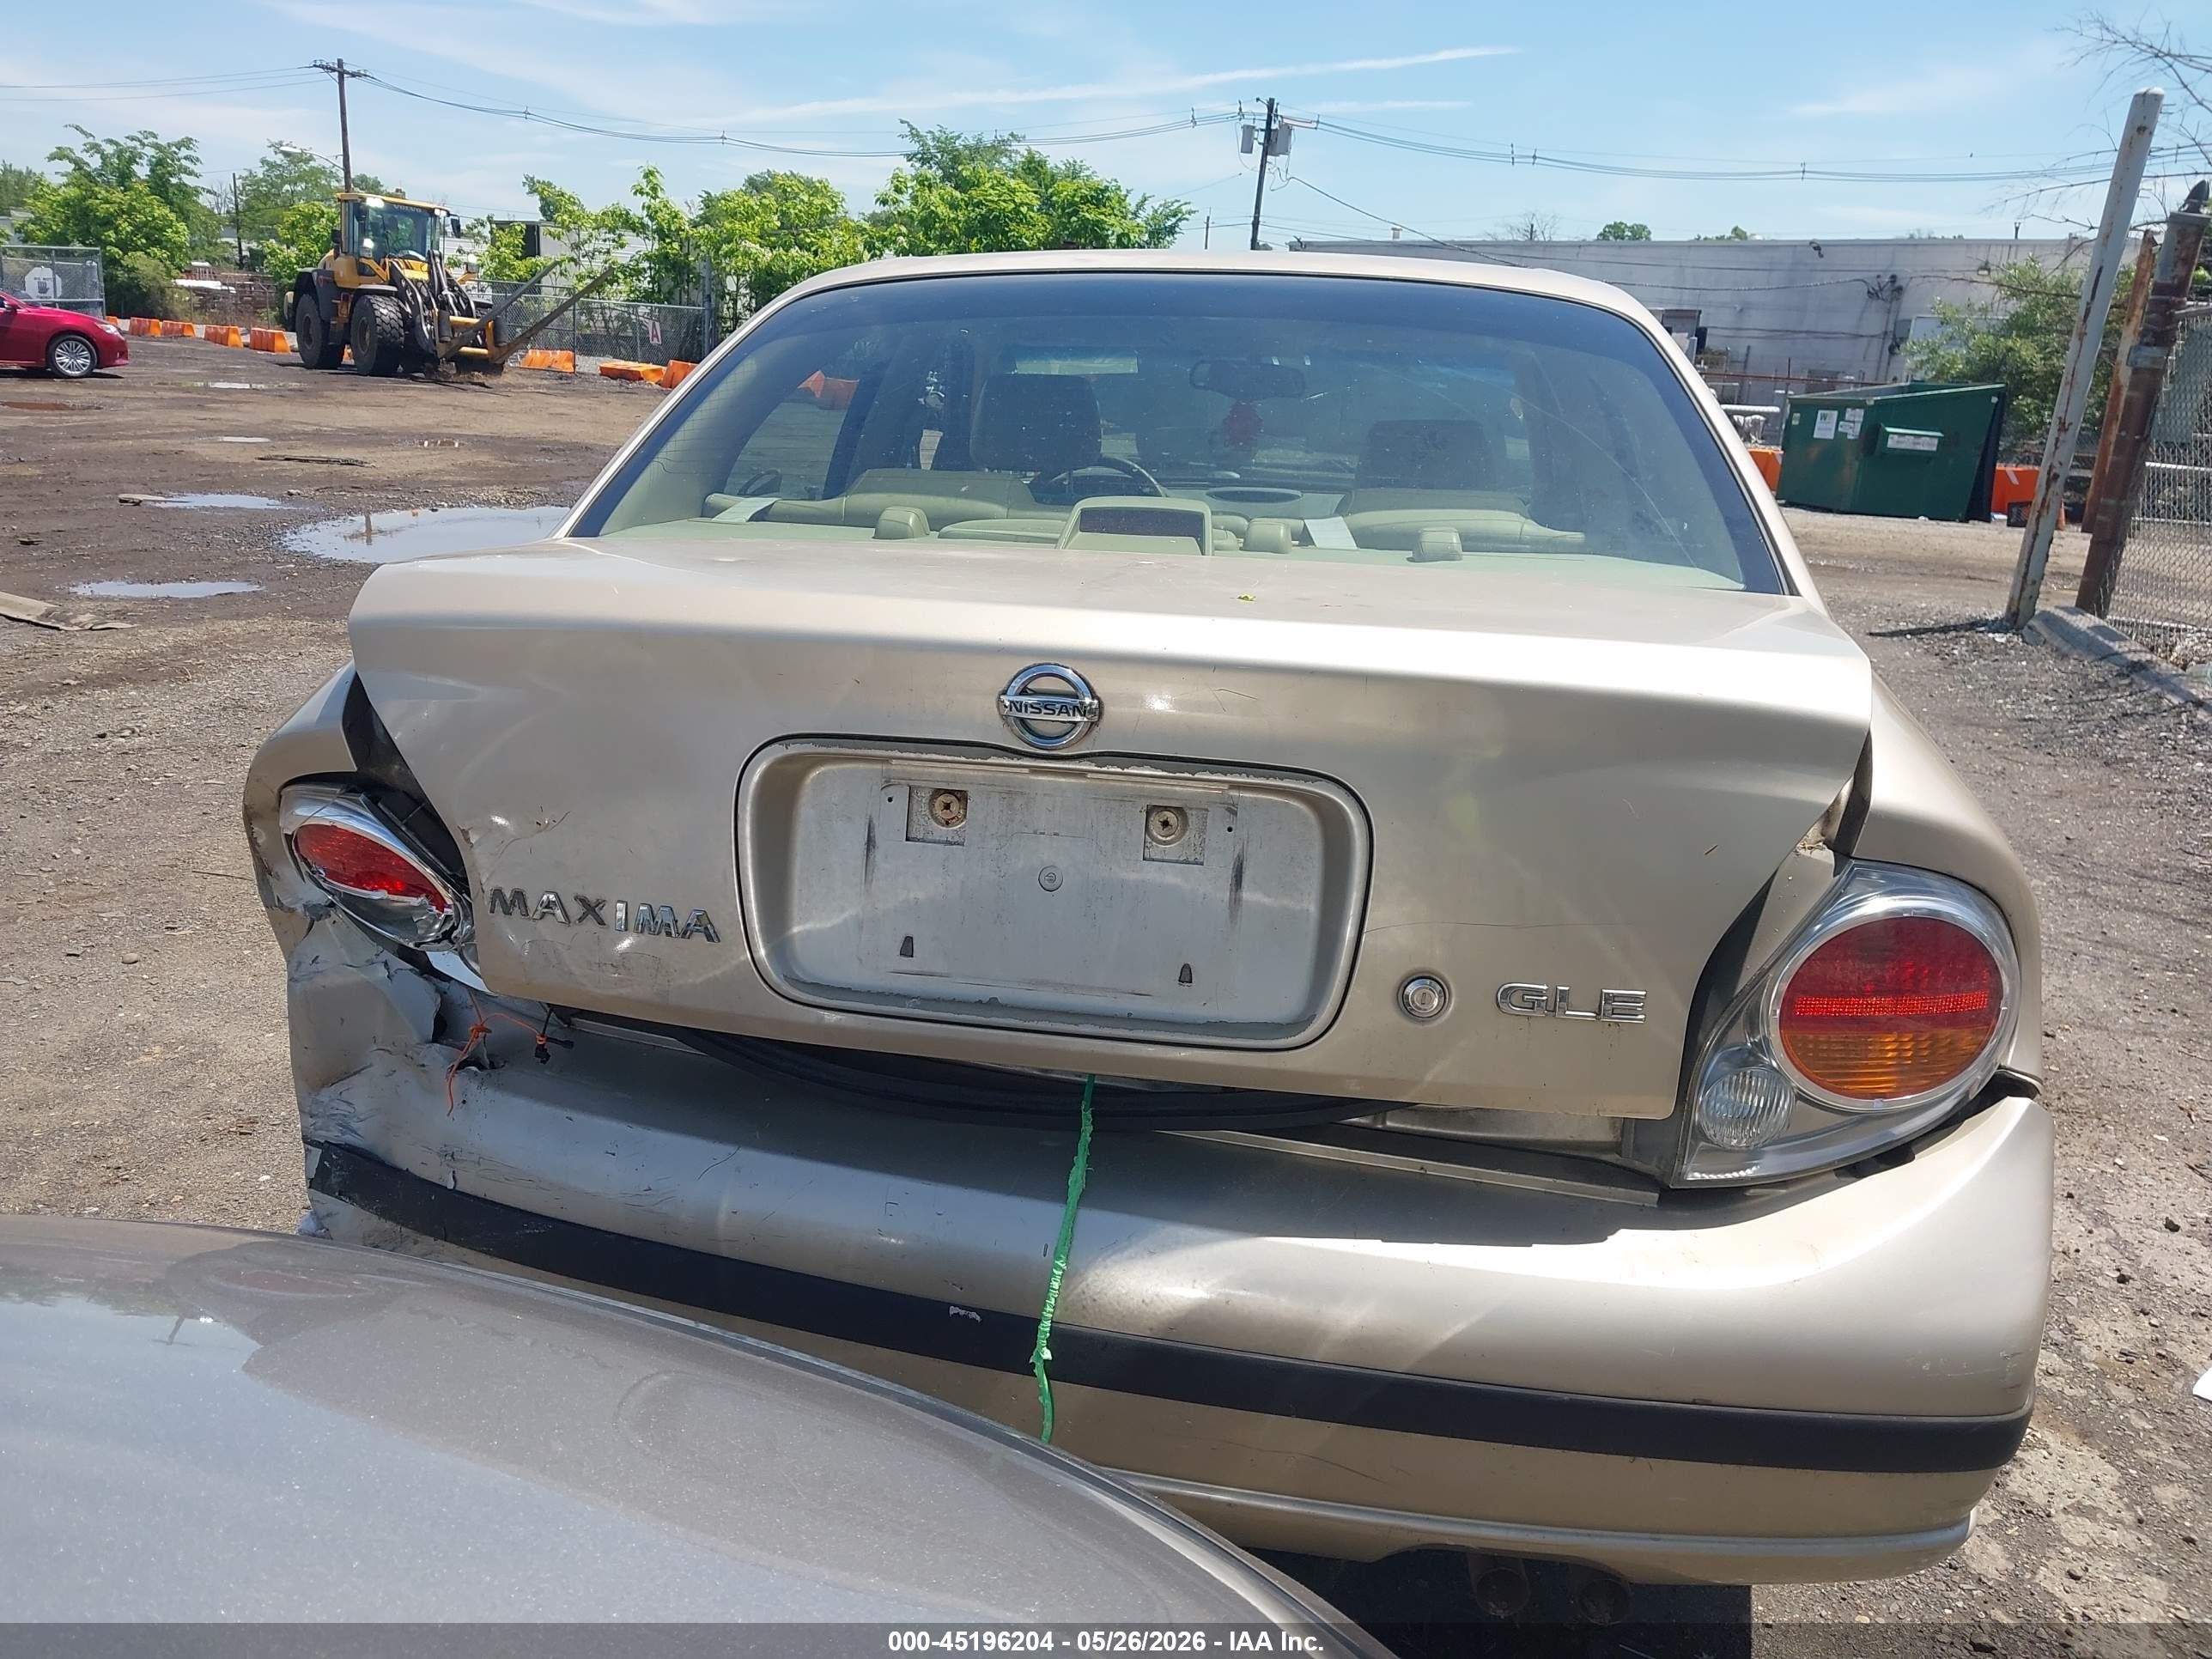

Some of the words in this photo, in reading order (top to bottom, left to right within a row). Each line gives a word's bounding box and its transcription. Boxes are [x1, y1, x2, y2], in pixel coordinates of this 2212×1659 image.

[651, 321, 660, 343] A
[1008, 700, 1087, 717] NISSAN
[489, 887, 721, 943] MAXIMA
[1497, 982, 1646, 1023] GLE
